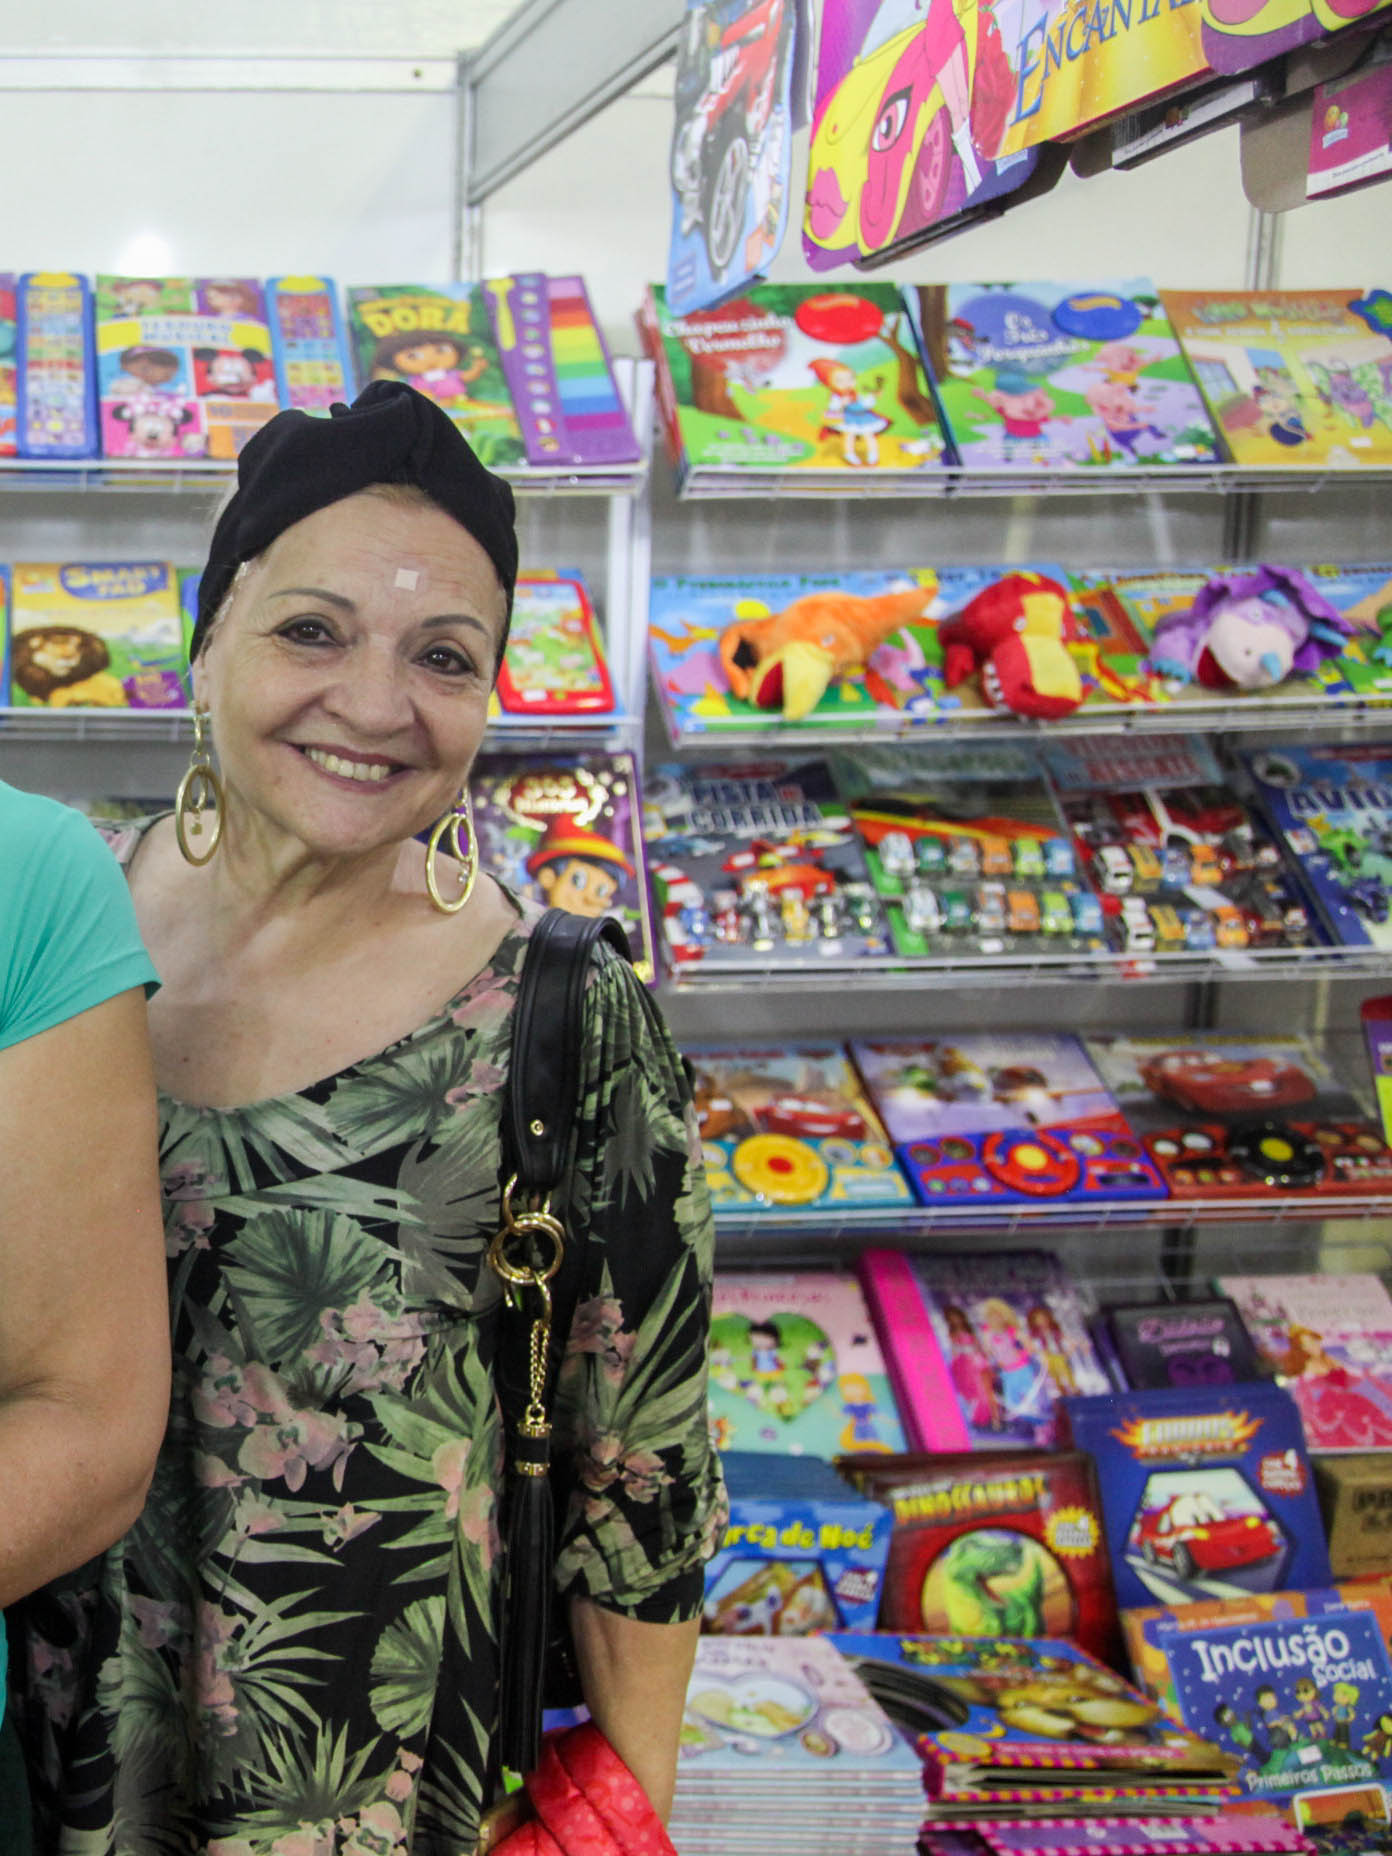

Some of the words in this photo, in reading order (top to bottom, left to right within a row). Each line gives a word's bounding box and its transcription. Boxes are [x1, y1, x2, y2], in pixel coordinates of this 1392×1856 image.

[363, 306, 471, 338] DORA
[64, 565, 160, 588] SMART
[723, 1523, 778, 1549] rca
[1191, 1624, 1350, 1684] Inclusão
[1312, 1658, 1377, 1688] Social
[1245, 1768, 1319, 1792] Primeiros
[1319, 1762, 1373, 1785] Passos
